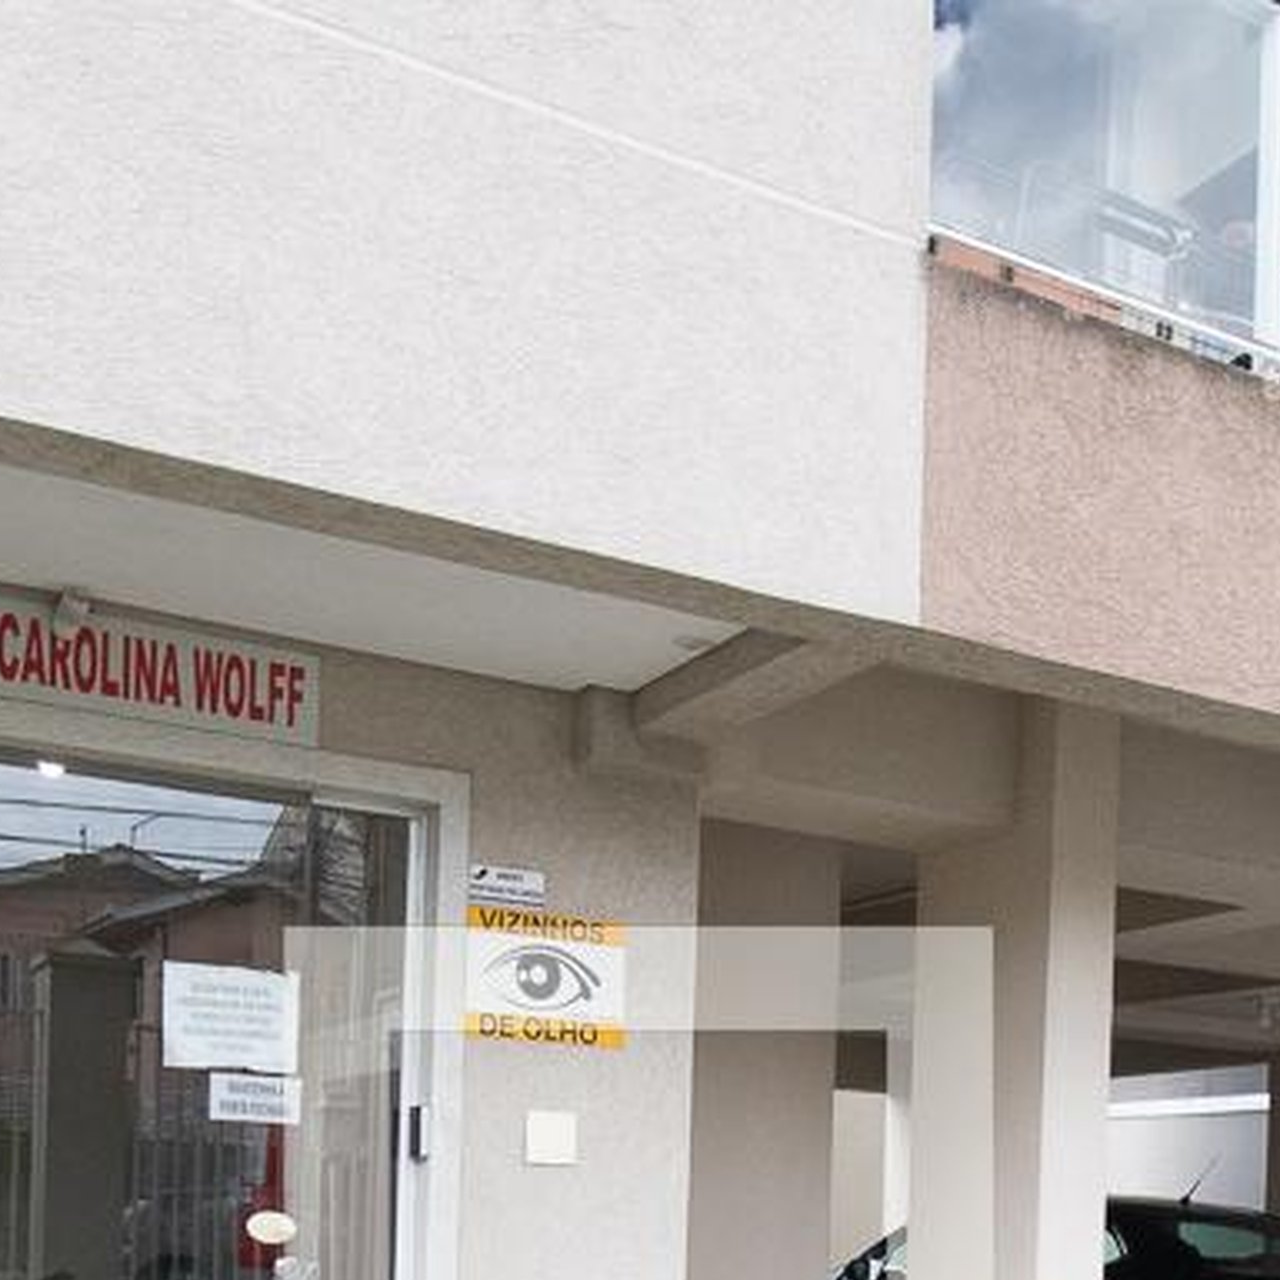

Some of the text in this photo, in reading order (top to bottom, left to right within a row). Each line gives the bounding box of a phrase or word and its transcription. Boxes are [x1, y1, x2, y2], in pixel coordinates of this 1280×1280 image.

[193, 645, 306, 728] WOLFF
[478, 907, 605, 944] VIZINHOS
[478, 1012, 599, 1046] DE OLHO
